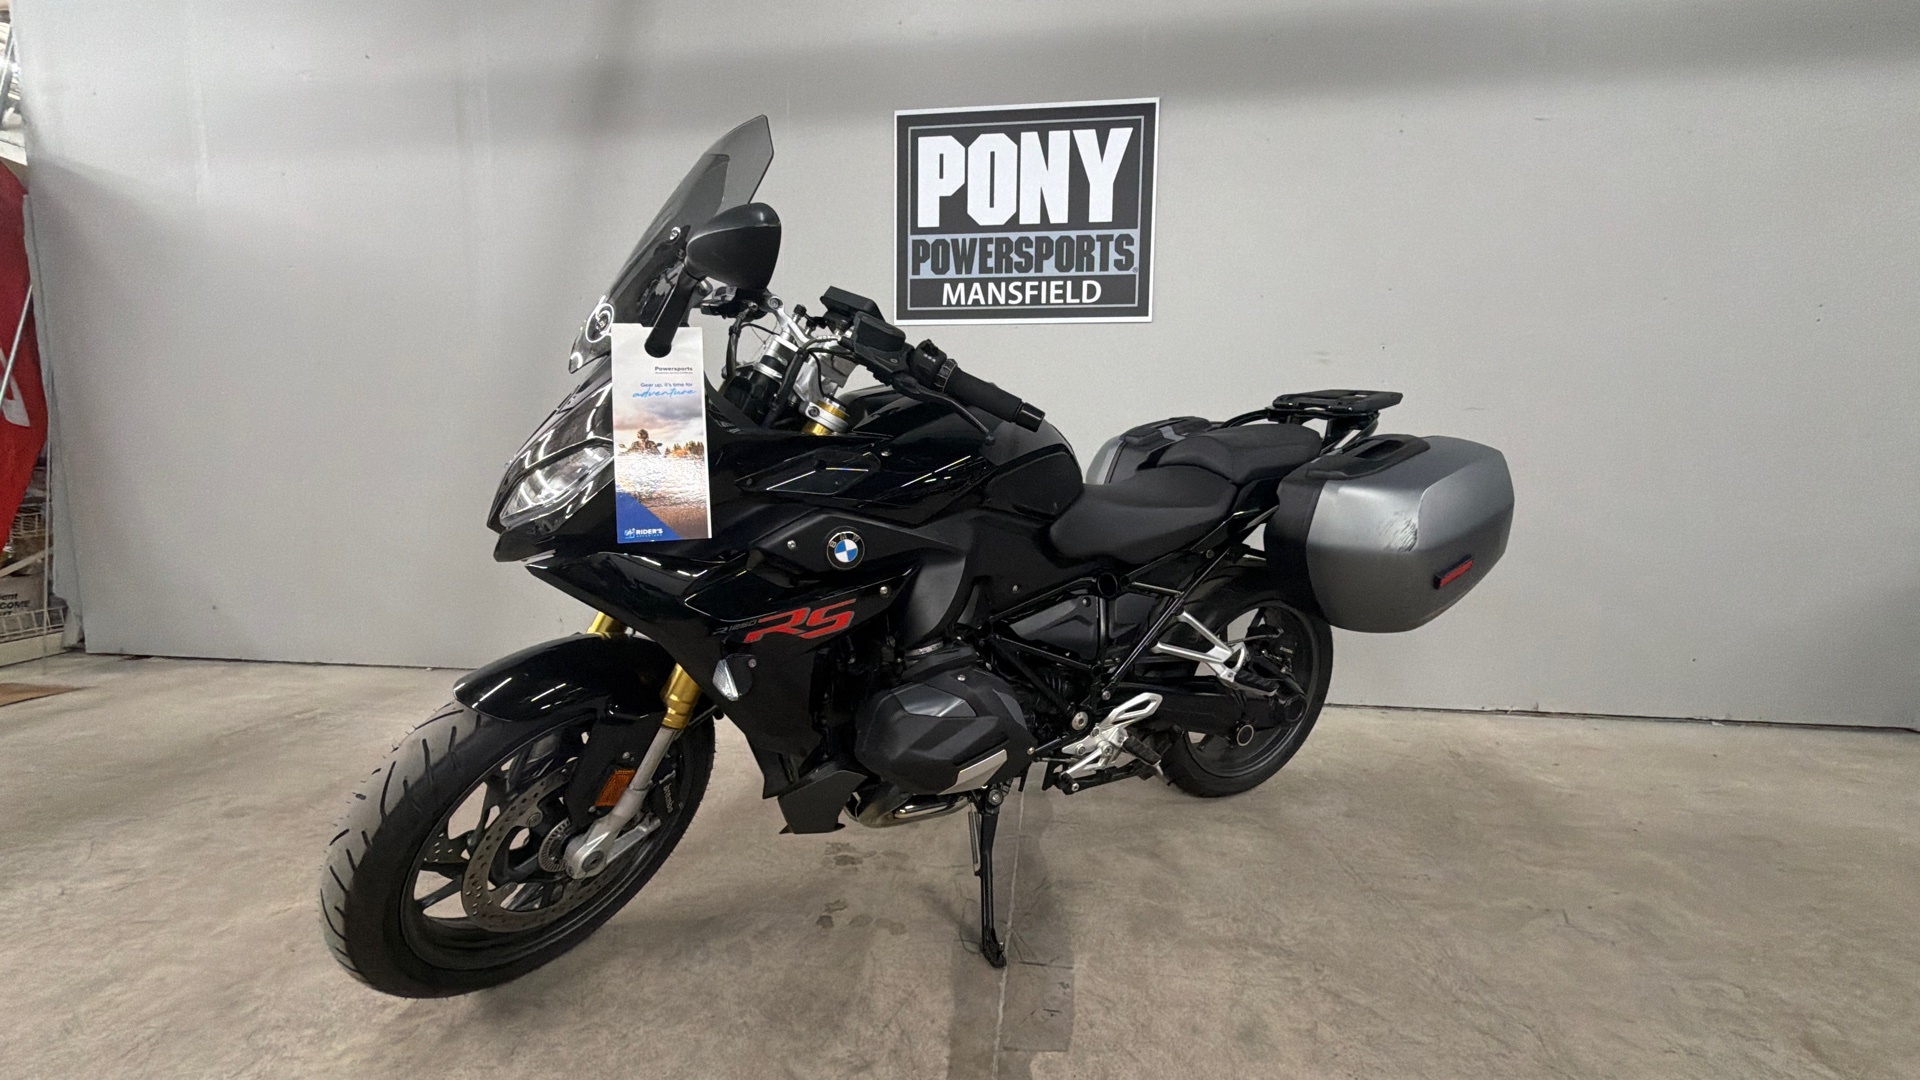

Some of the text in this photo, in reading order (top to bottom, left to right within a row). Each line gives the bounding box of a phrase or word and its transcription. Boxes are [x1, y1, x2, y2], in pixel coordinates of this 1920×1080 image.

[917, 127, 1134, 228] PONY
[911, 233, 1135, 275] POWERSPORTS
[942, 280, 1102, 306] MANSFIELD
[632, 387, 696, 398] adventure
[635, 528, 664, 536] RIDER'S
[829, 532, 861, 549] BMW
[743, 598, 857, 644] RS
